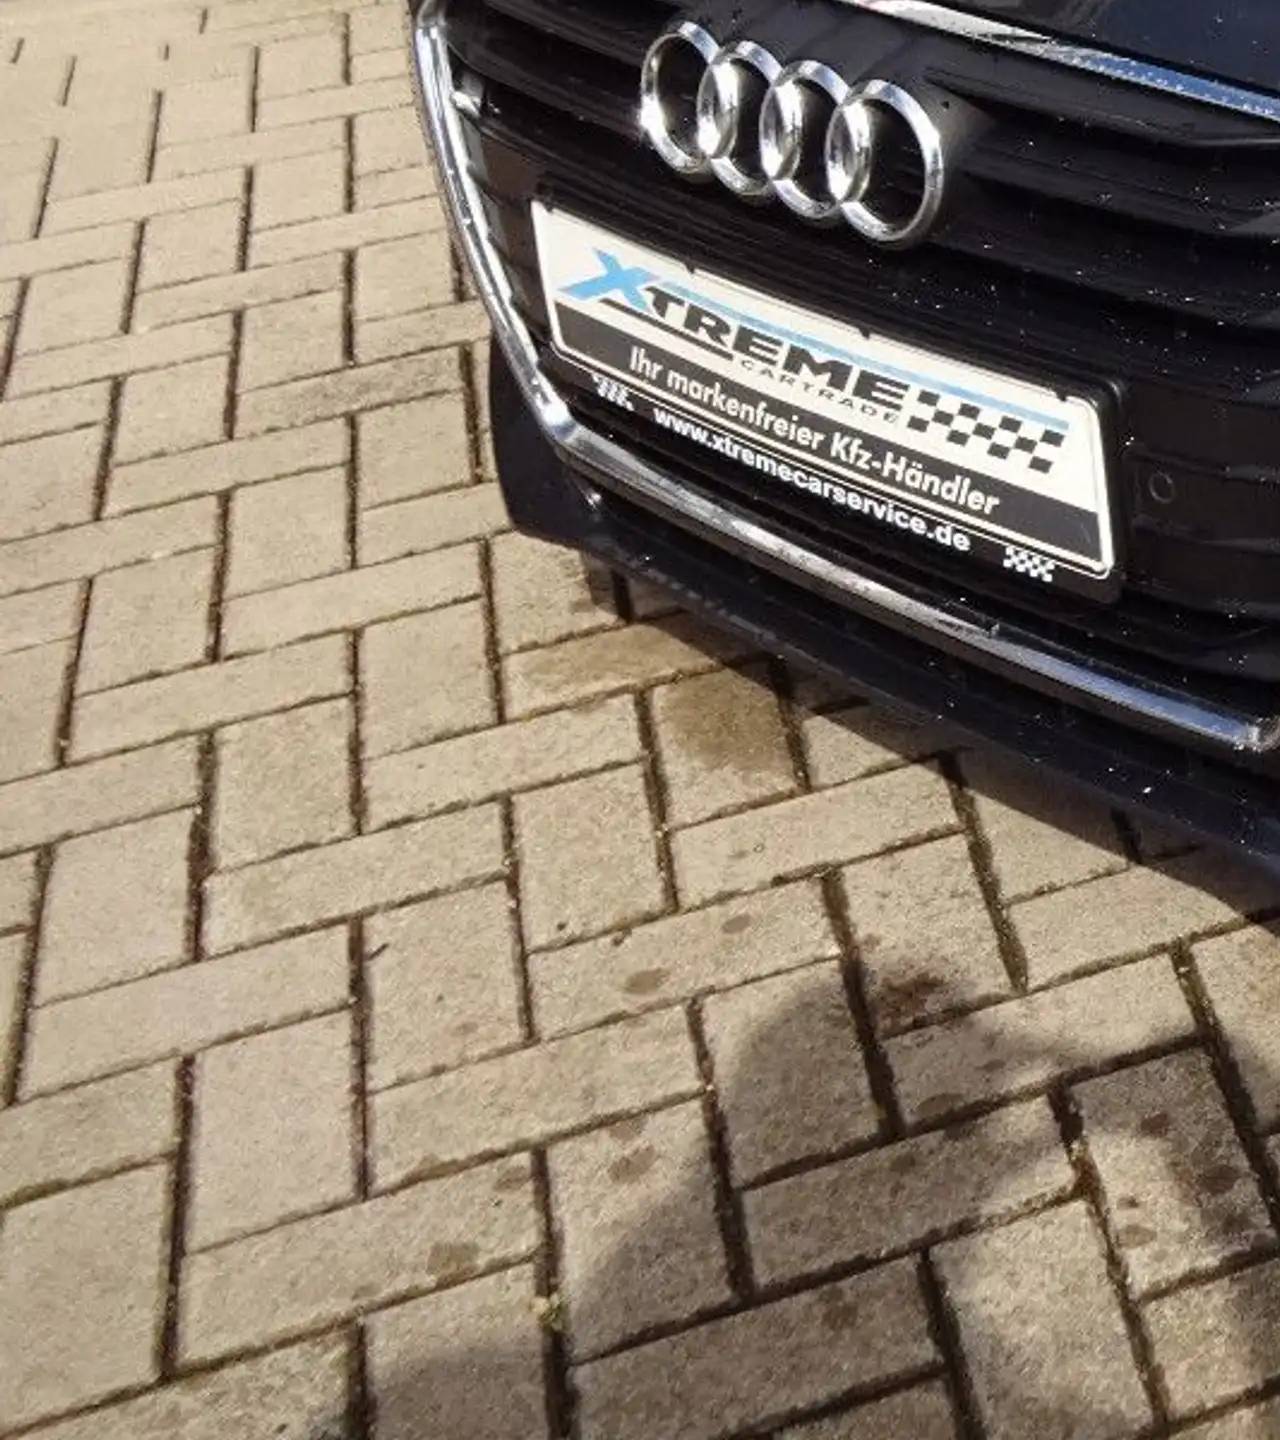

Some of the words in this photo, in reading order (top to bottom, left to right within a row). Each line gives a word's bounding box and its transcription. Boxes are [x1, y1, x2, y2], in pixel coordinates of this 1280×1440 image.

[558, 247, 909, 410] XTREME
[739, 357, 901, 425] CARTRADE
[629, 344, 664, 380] Ihr
[666, 368, 825, 449] markenfreier
[830, 433, 1000, 515] Kfz-Händler
[652, 407, 972, 552] www.xtremecarservice.de
